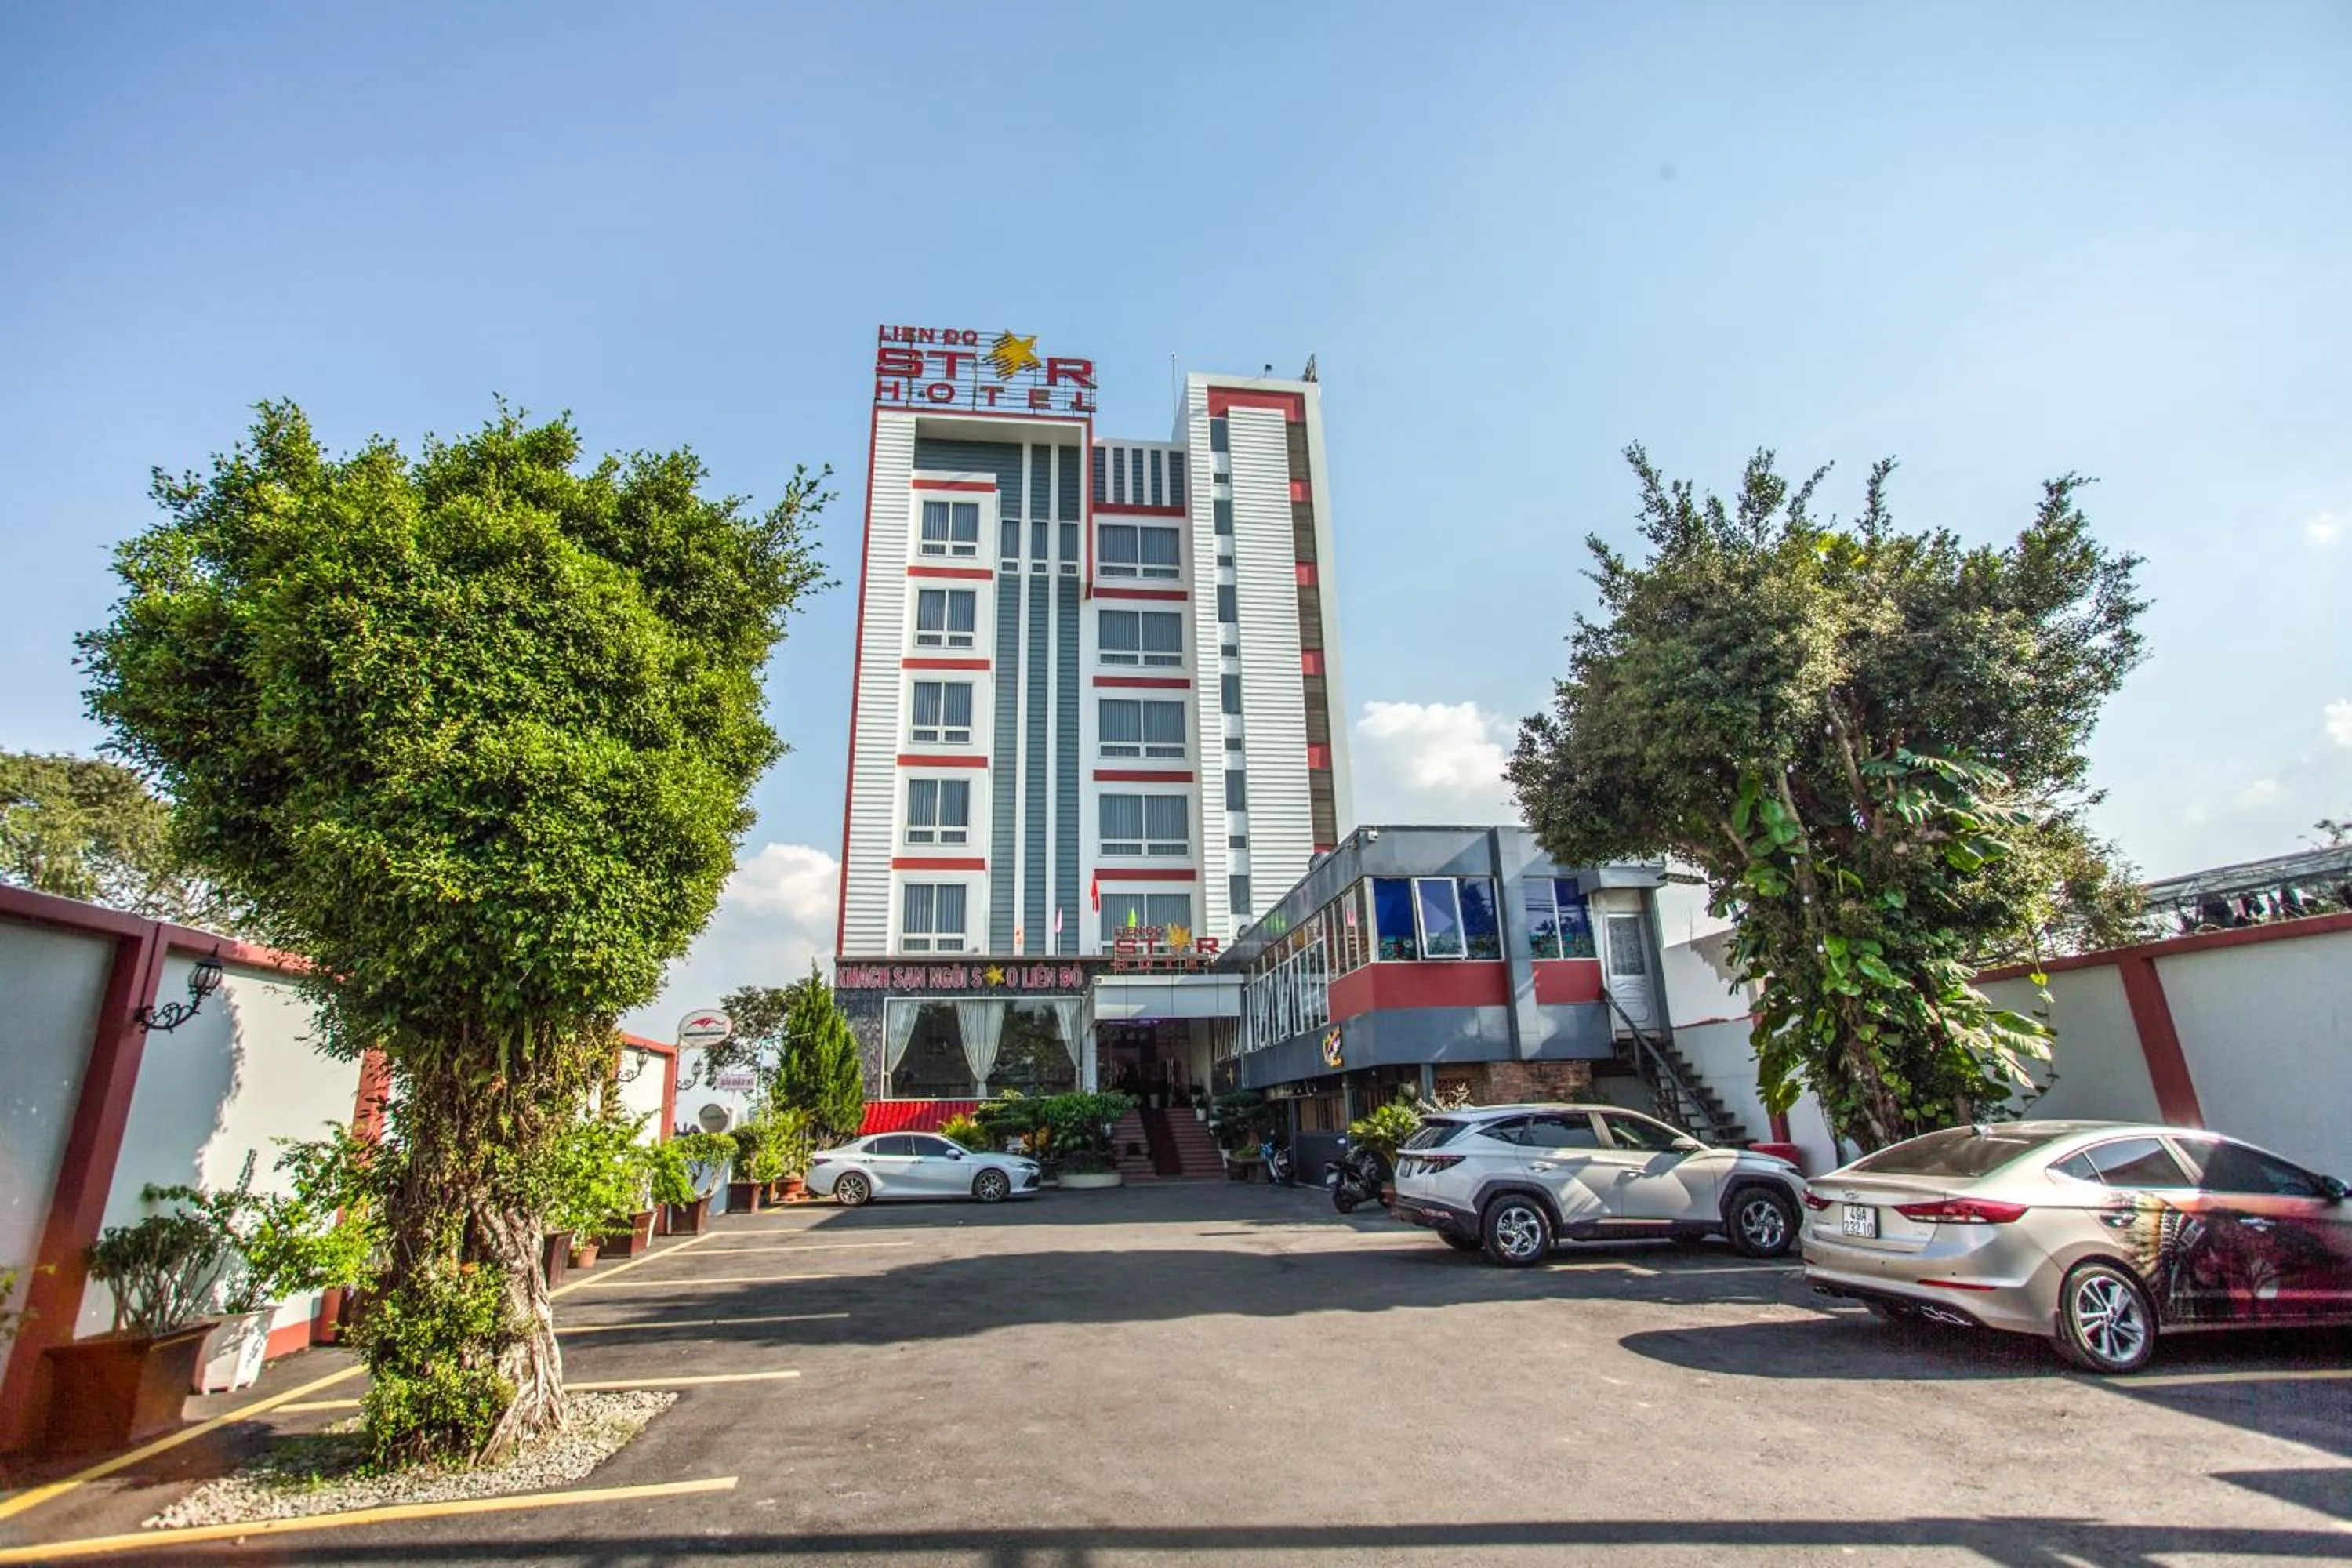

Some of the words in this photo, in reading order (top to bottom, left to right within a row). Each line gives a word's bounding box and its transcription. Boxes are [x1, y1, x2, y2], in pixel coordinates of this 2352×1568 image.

[879, 325, 935, 343] LIEN
[876, 347, 1097, 389] STR
[876, 380, 1097, 412] HOTEL
[1116, 936, 1221, 954] STR
[838, 964, 890, 989] KHÁCH
[893, 966, 926, 991] SẠN
[929, 963, 968, 989] NGÔI
[971, 964, 1018, 989] SO
[1022, 962, 1056, 989] LIÊN
